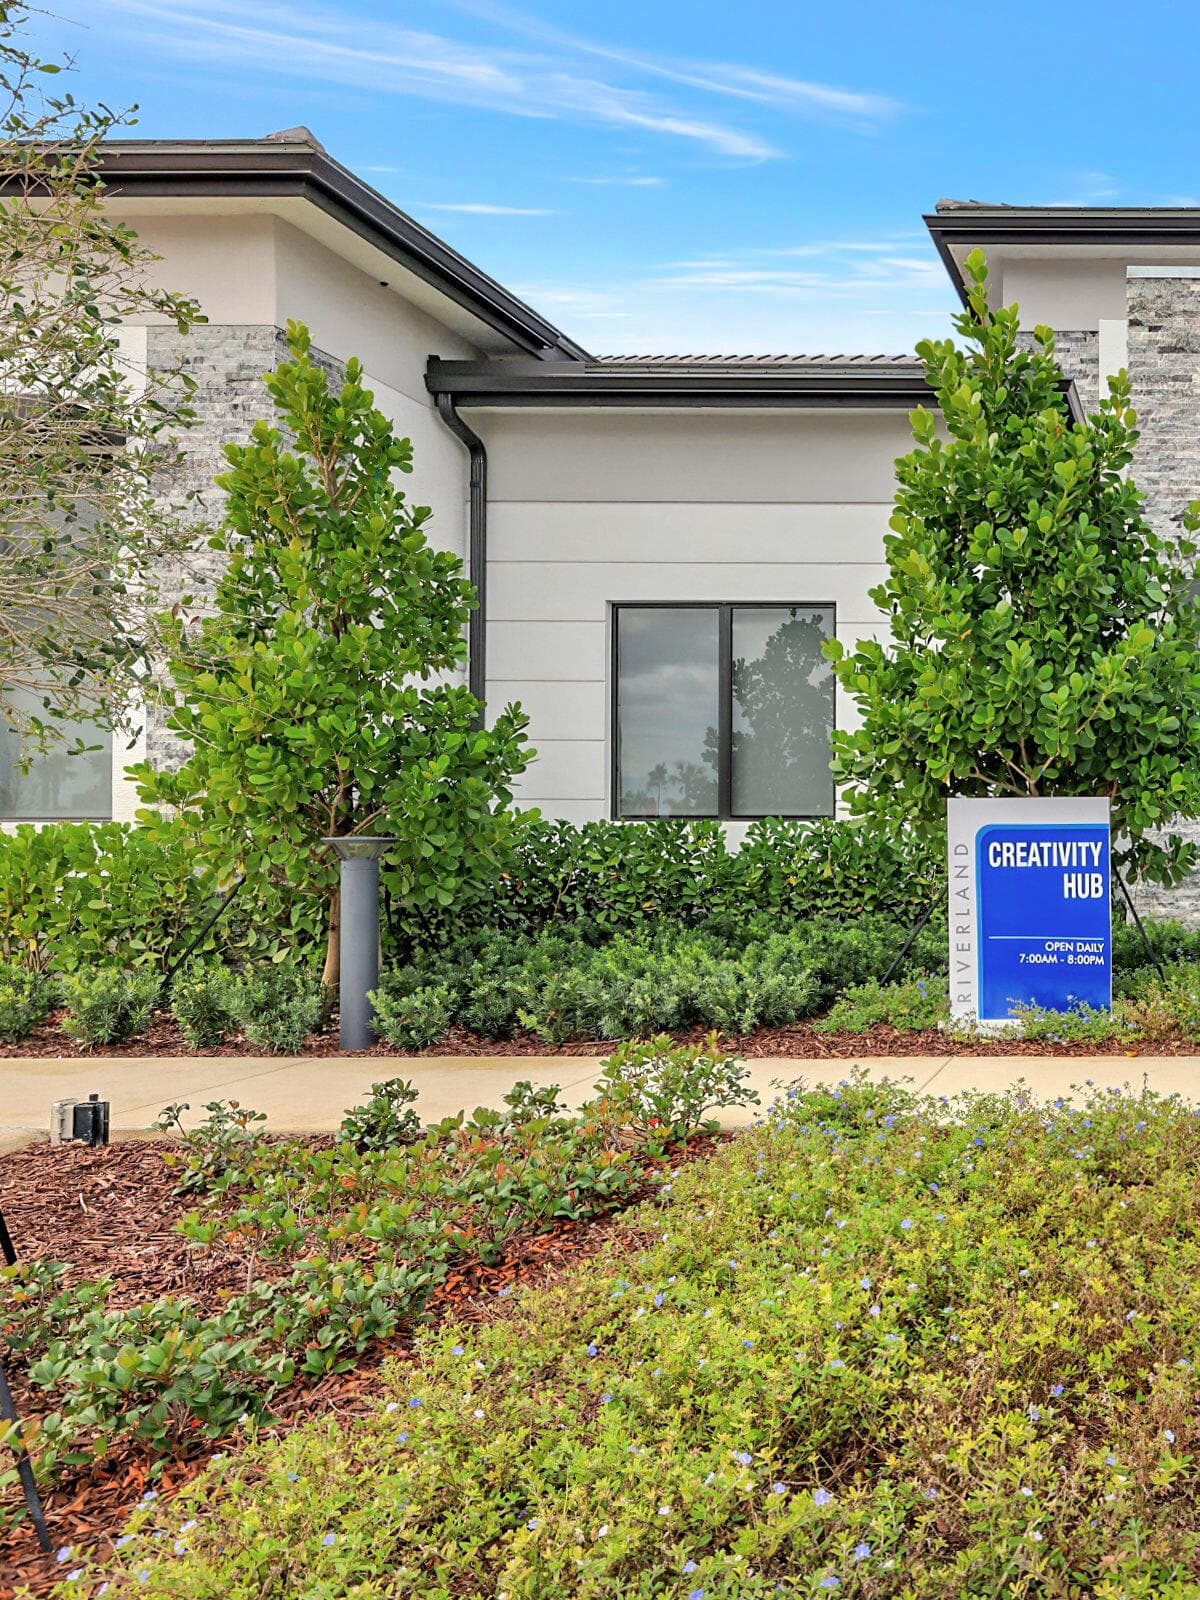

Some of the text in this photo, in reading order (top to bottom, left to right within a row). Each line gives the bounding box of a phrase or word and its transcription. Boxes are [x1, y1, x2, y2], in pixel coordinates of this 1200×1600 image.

[988, 841, 1103, 868] CREATIVITY
[1063, 873, 1104, 899] HUB
[954, 843, 972, 1003] RIVERLAND
[1019, 953, 1058, 964] 7:00AM
[1067, 954, 1105, 965] 8:00PM
[1044, 942, 1105, 953] OPEN DAILY
